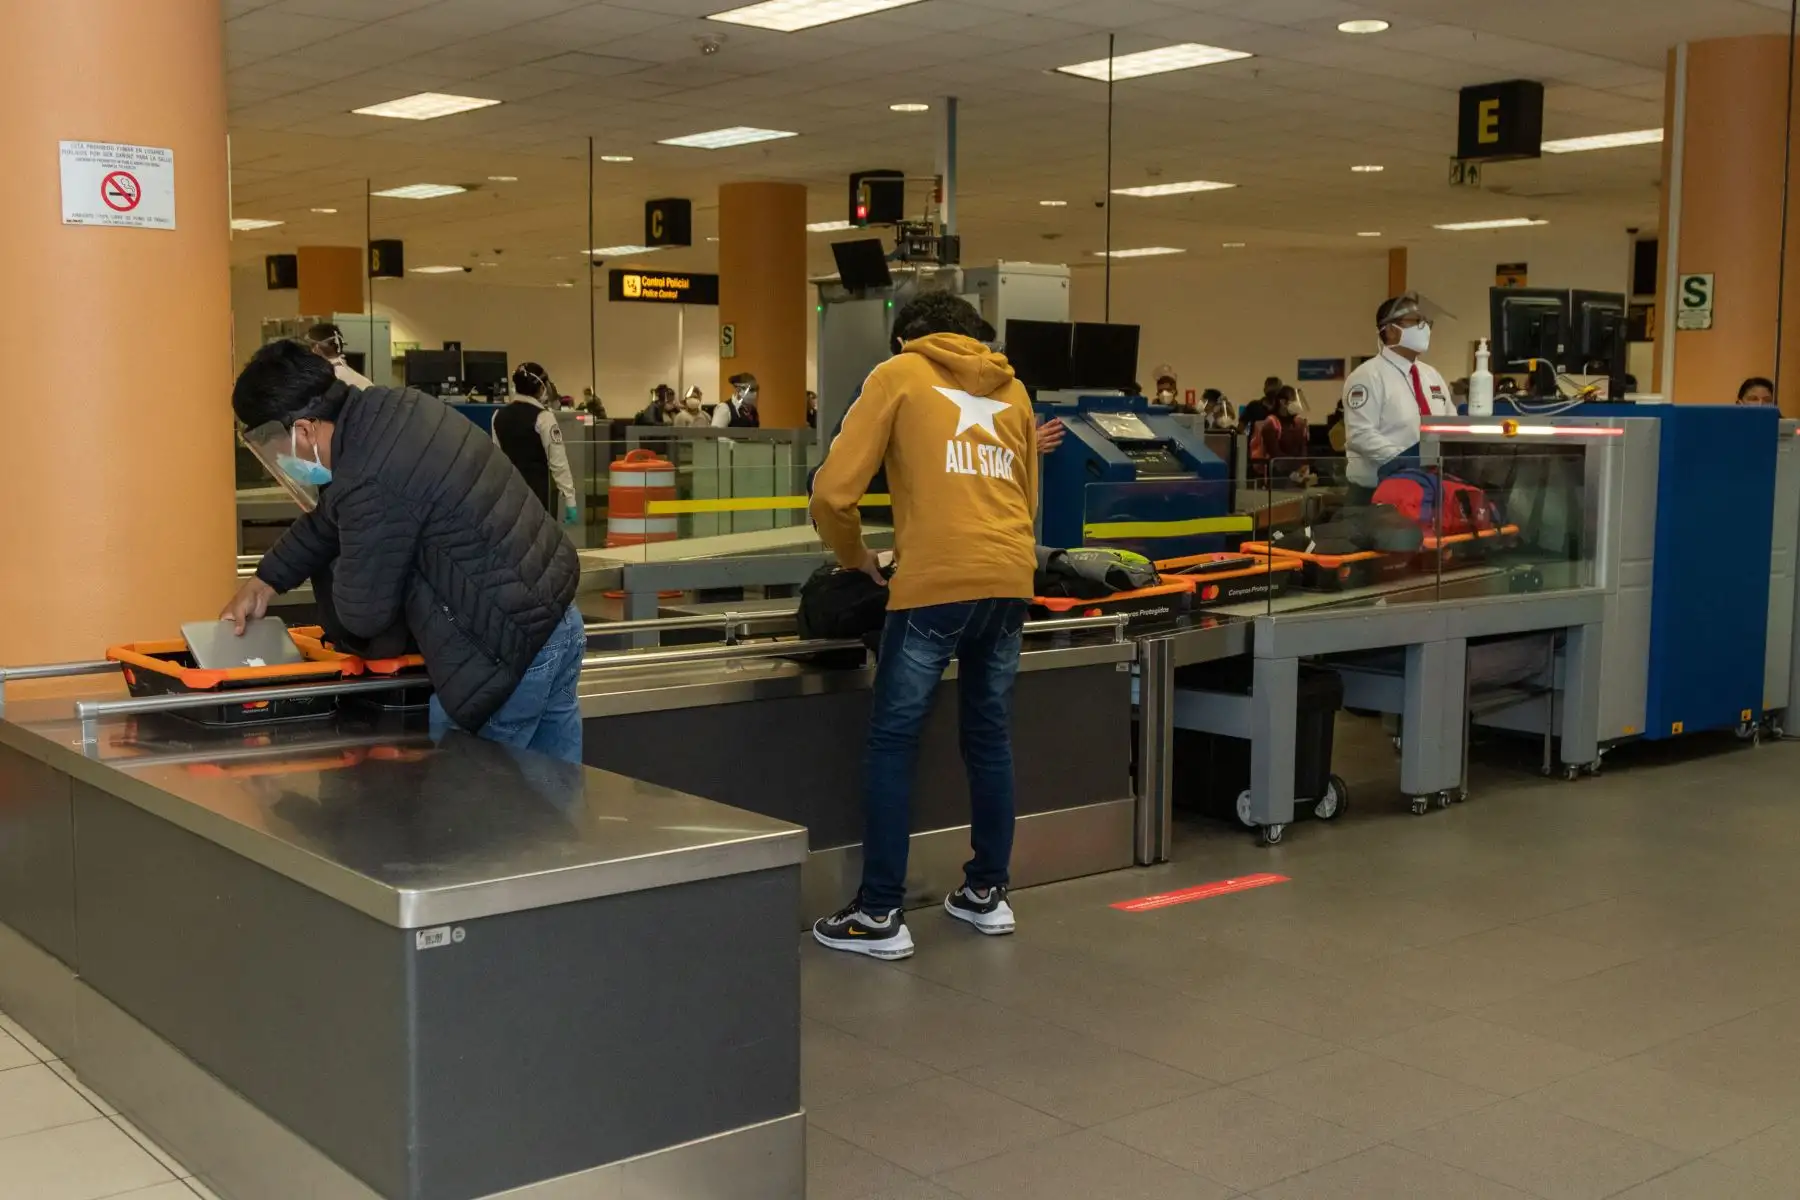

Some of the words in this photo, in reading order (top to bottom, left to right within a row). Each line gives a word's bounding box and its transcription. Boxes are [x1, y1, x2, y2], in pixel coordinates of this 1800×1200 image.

[1478, 99, 1500, 144] E
[652, 209, 663, 239] C
[372, 248, 380, 271] B
[641, 276, 665, 287] Control
[666, 277, 690, 289] Policial
[641, 288, 659, 298] Police
[1683, 276, 1707, 308] S
[723, 326, 733, 345] S
[945, 439, 978, 475] ALL
[977, 443, 1015, 481] STAR
